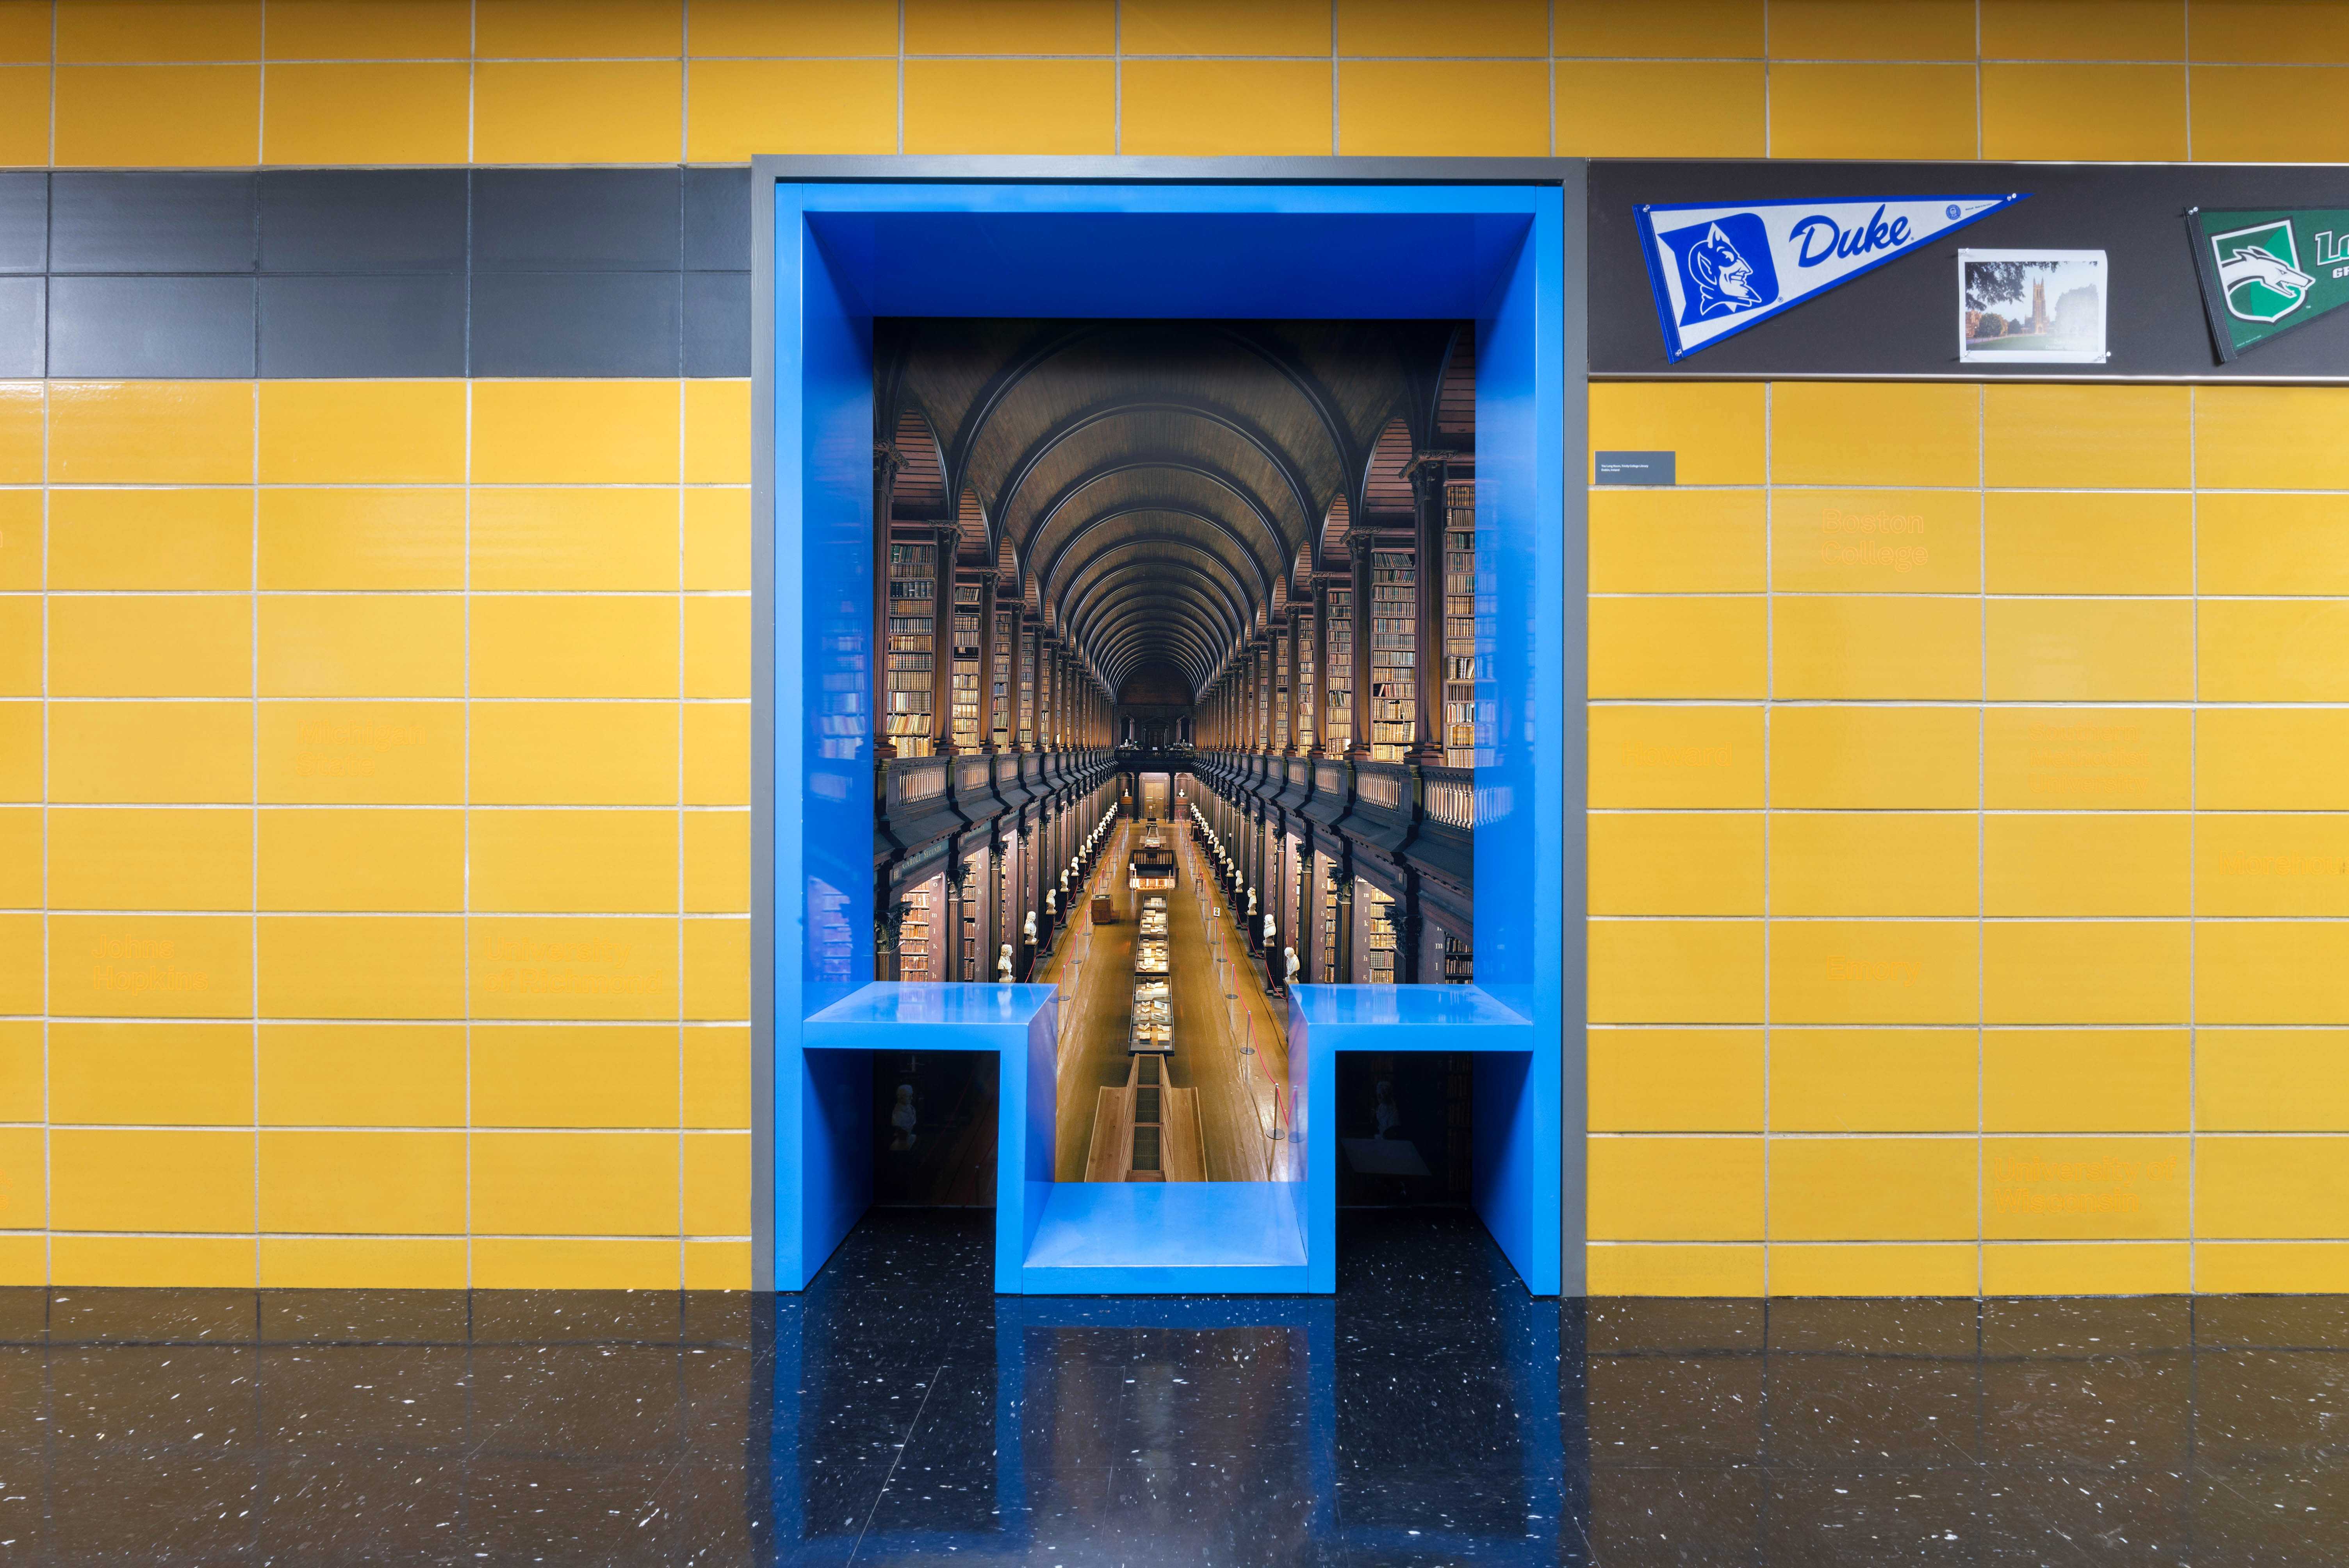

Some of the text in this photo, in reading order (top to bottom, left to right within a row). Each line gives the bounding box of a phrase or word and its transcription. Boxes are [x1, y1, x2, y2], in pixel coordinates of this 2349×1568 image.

[1789, 203, 1911, 268] Duke
[1822, 509, 1924, 534] Boston
[1821, 540, 1928, 572] College
[297, 718, 428, 752] Michigan
[2028, 721, 2139, 742] Southern
[296, 751, 376, 777] State
[1622, 741, 1733, 767] Howard
[2030, 747, 2150, 768] Methodist
[2028, 772, 2149, 798] University
[2218, 849, 2349, 875] Morehou
[91, 934, 175, 959] Johns
[484, 937, 632, 969] University
[1435, 962, 1438, 971] l
[1825, 955, 1921, 987] Emory
[93, 965, 209, 996] Hopkins
[483, 968, 663, 995] of Richmond
[1993, 1155, 2178, 1187] University of
[1993, 1187, 2139, 1213] Wisconsin
